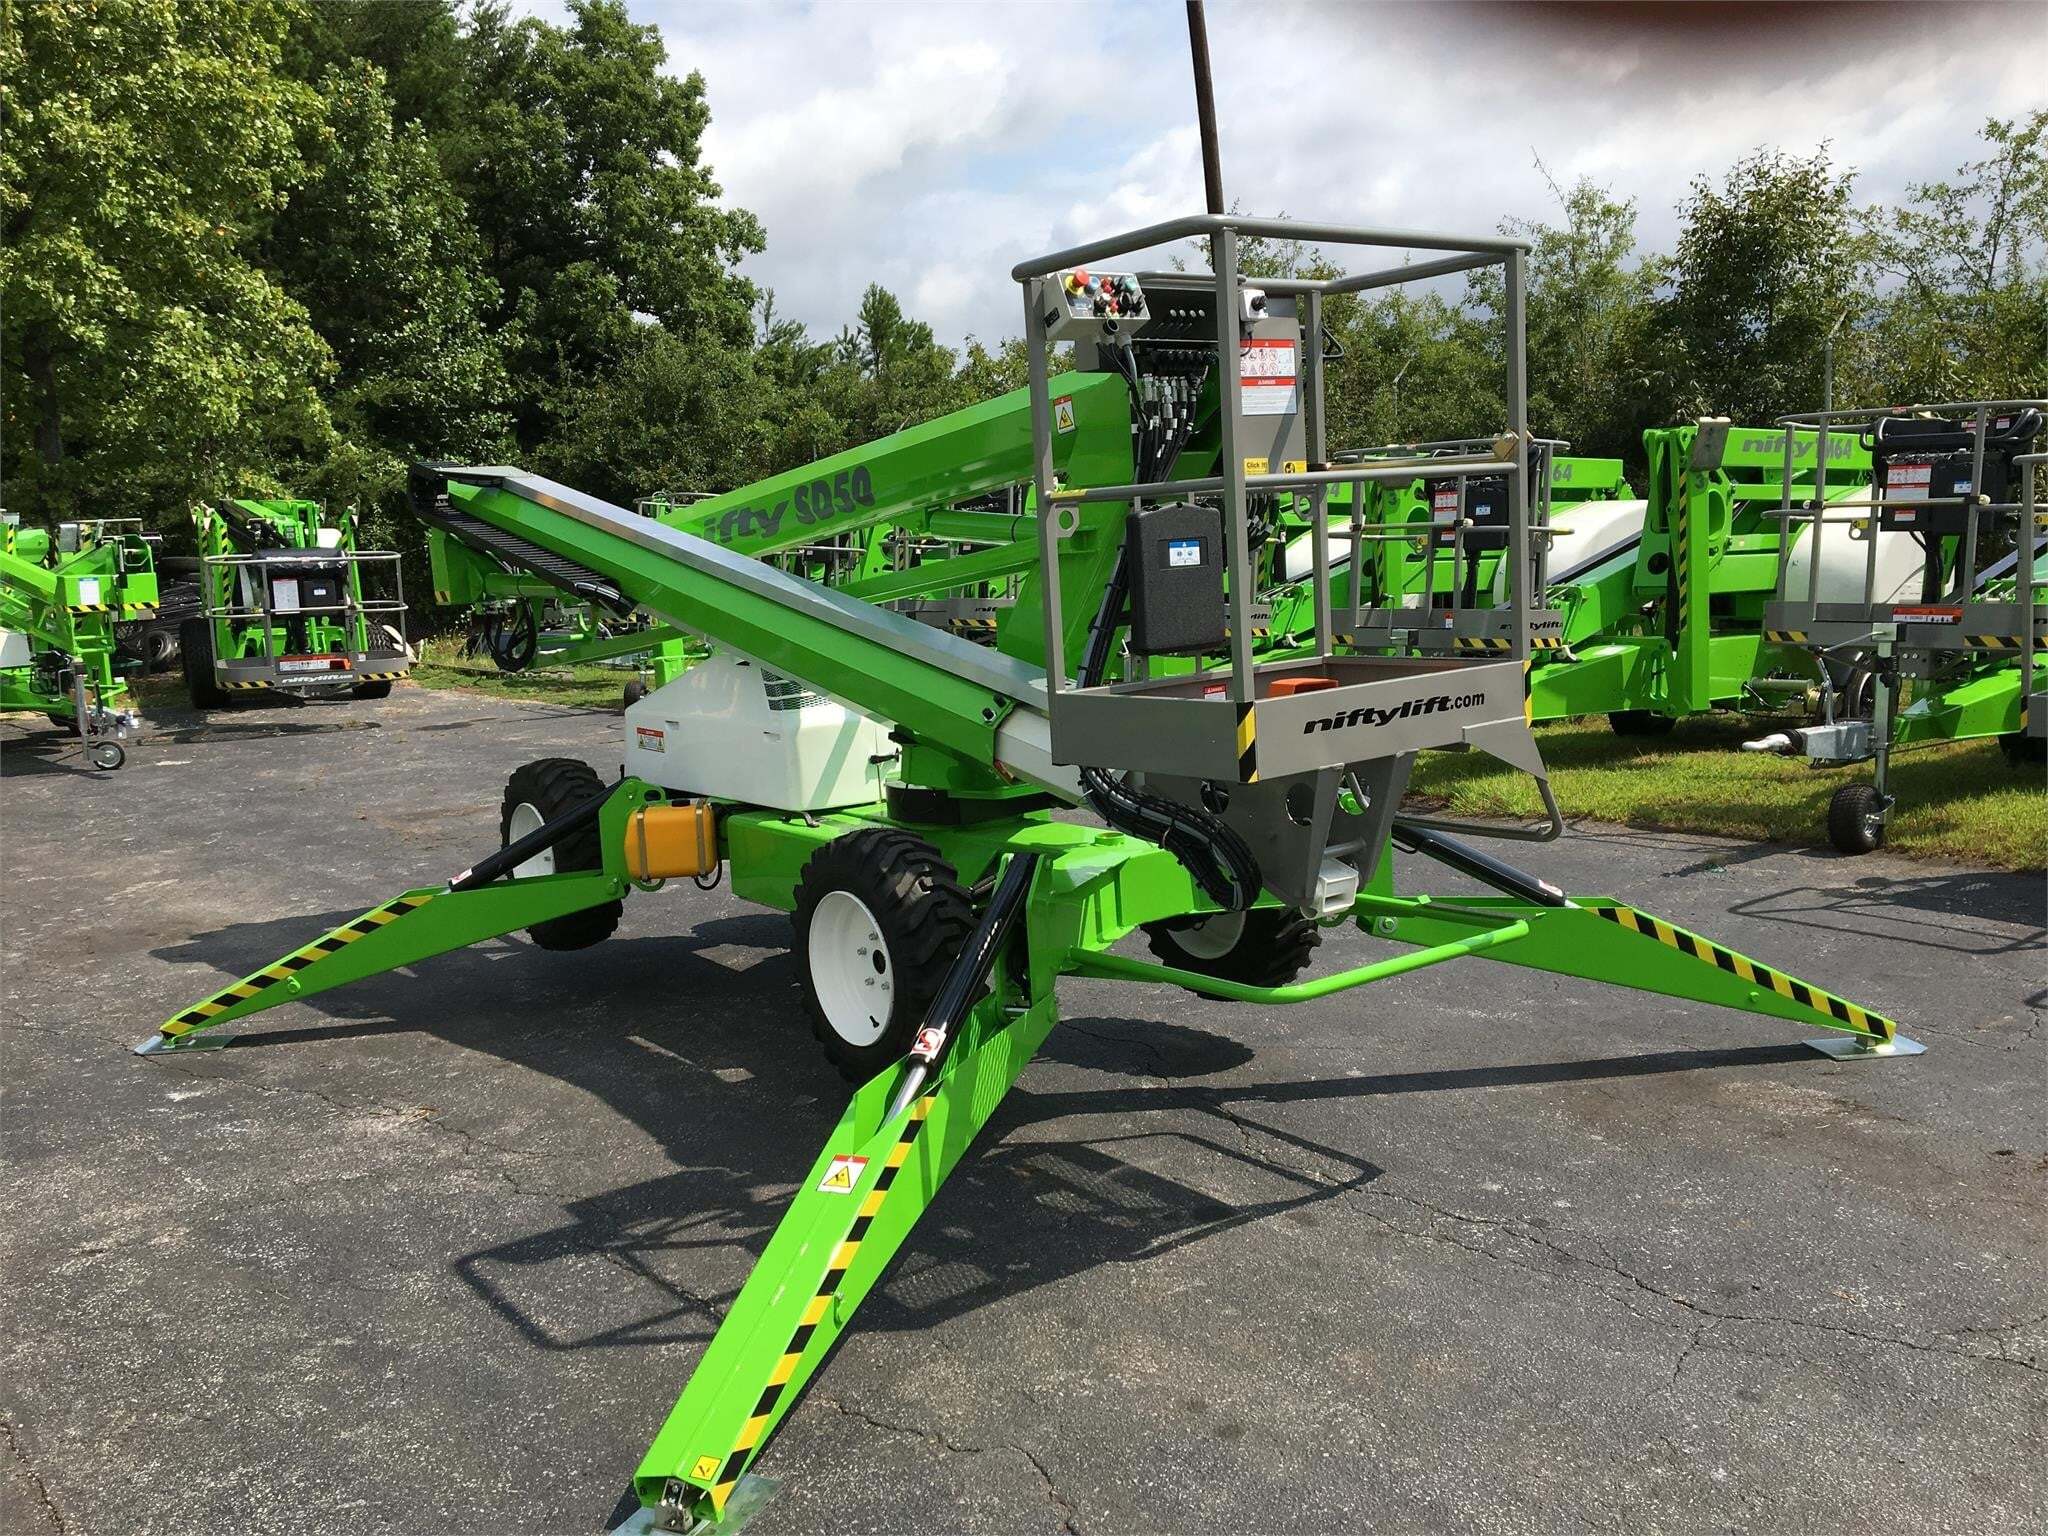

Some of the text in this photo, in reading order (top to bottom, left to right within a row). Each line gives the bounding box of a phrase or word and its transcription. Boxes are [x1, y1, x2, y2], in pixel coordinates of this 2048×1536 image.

[1552, 463, 1573, 482] 64
[703, 465, 876, 545] ifty SD50
[1303, 691, 1485, 735] niftylift.com
